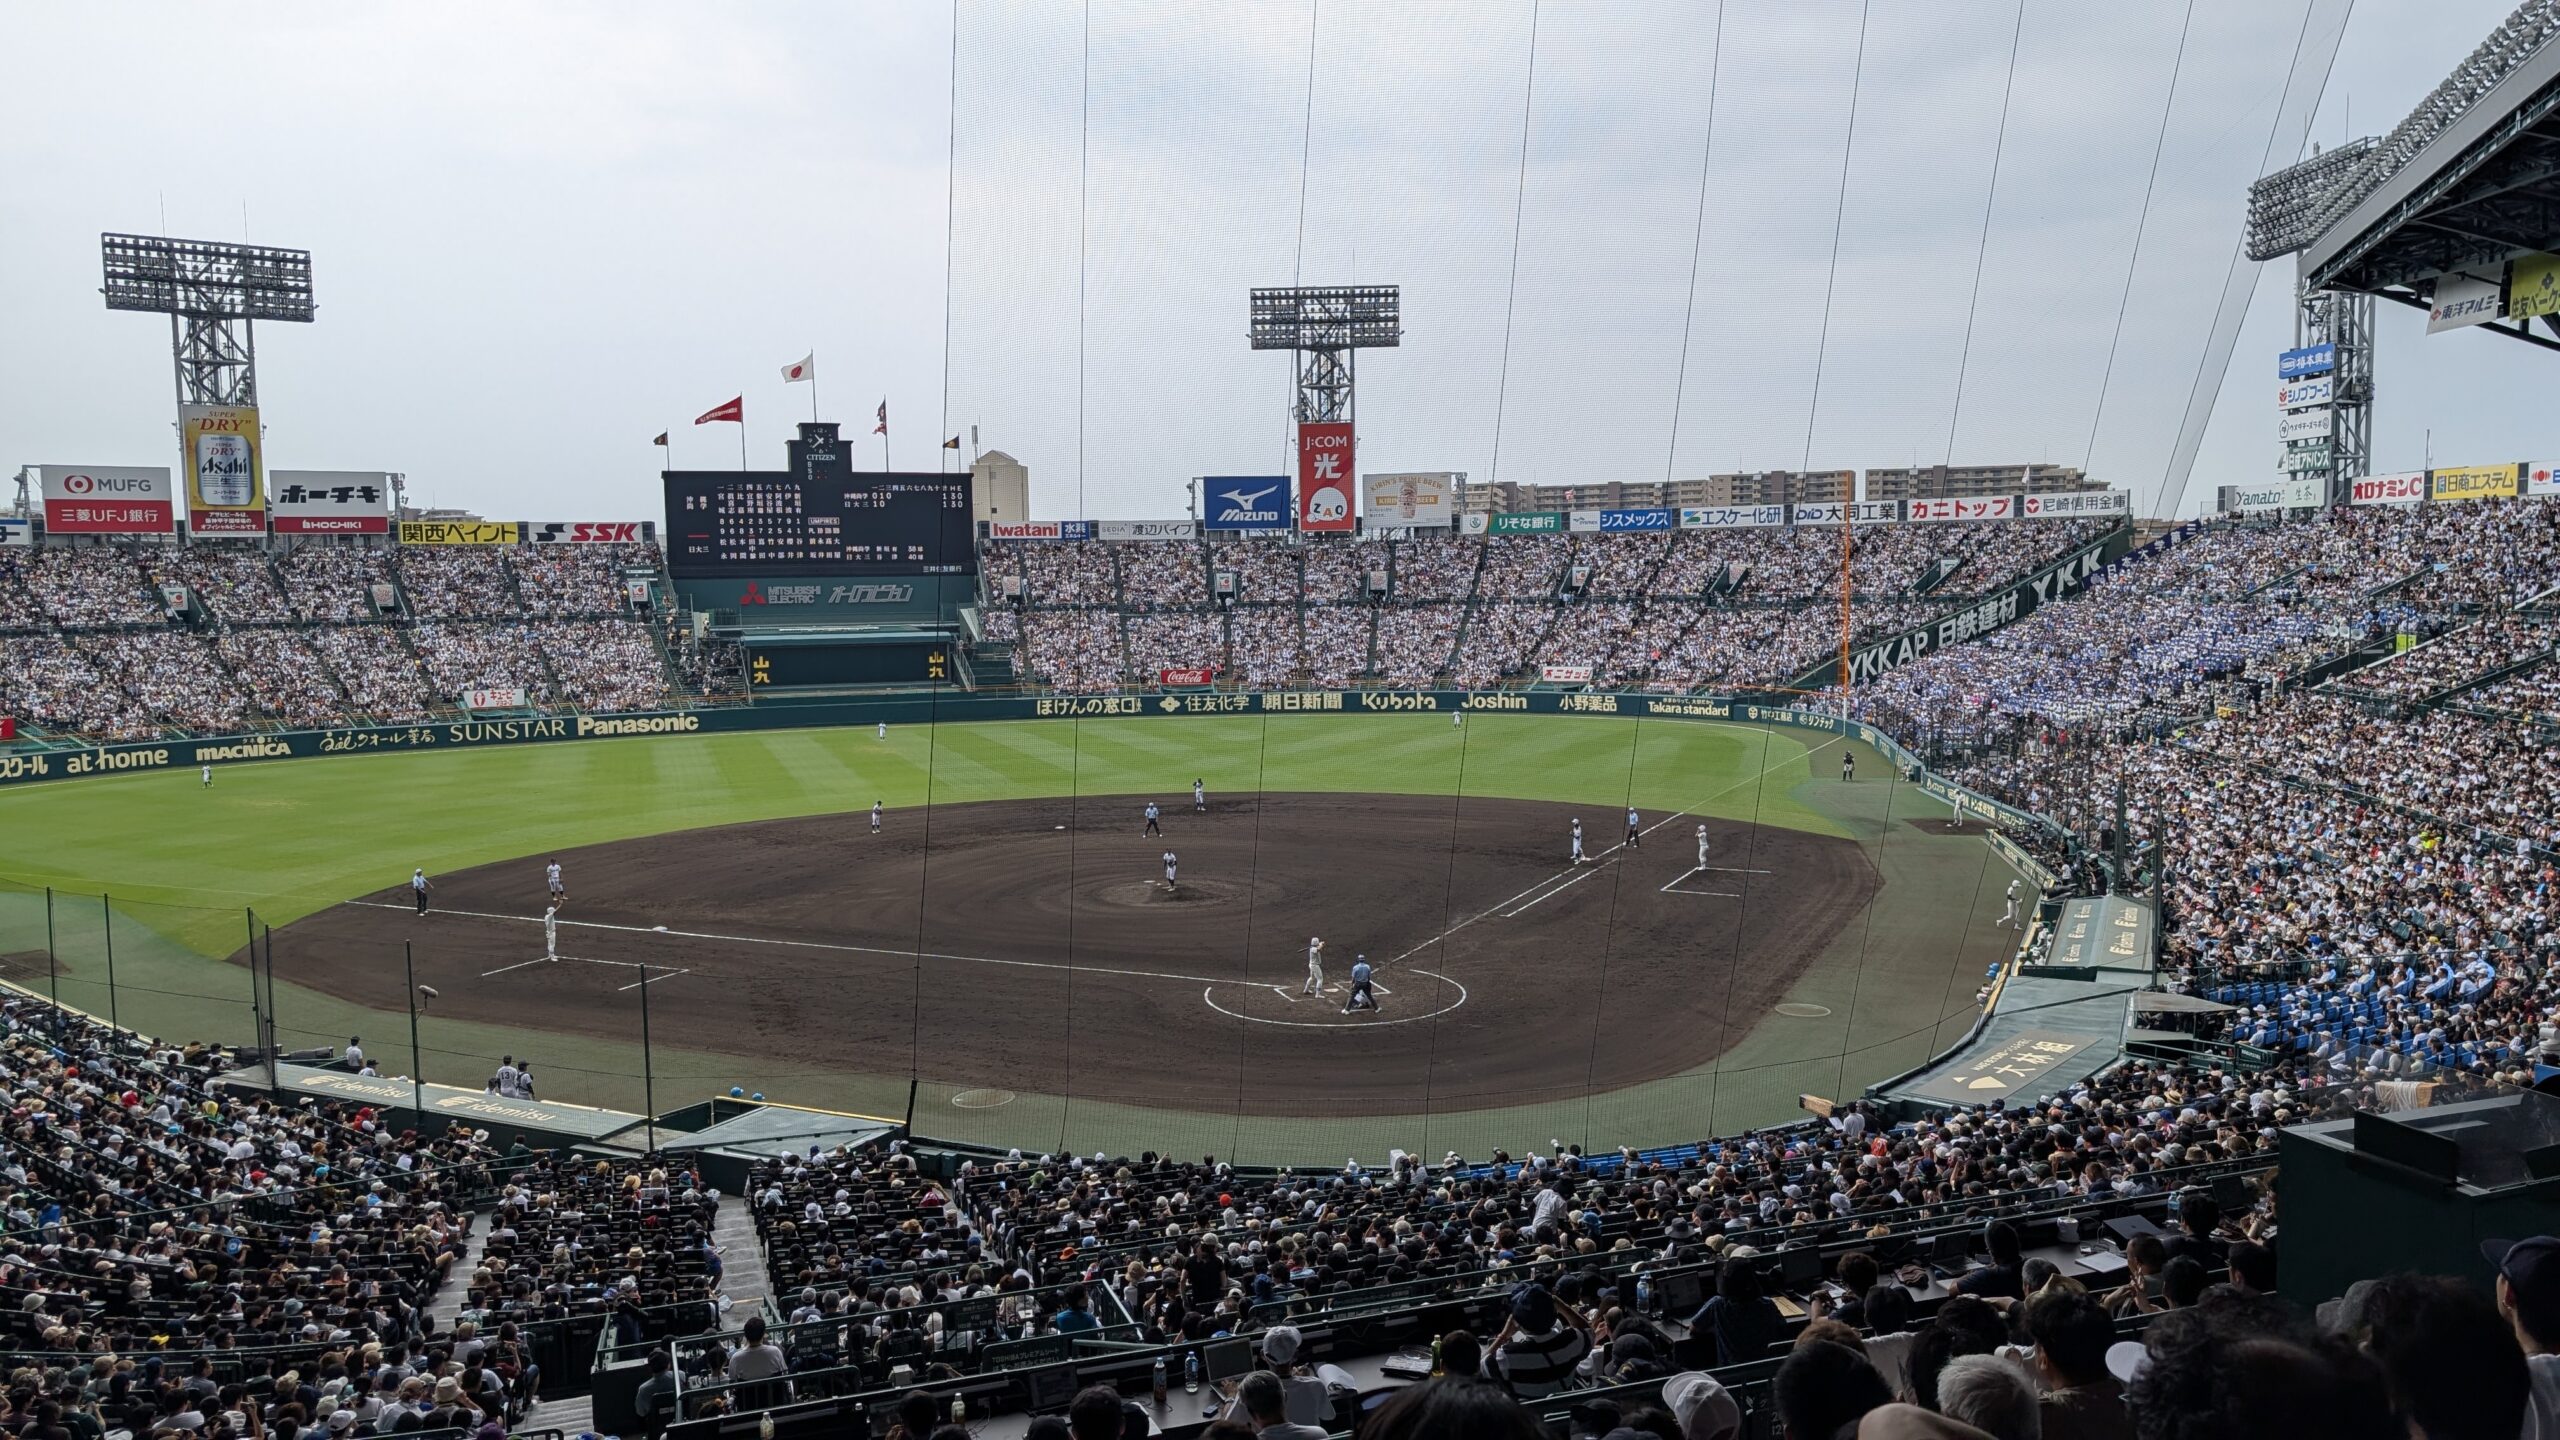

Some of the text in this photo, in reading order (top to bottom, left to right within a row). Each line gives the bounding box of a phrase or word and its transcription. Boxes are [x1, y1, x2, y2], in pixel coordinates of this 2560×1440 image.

[2442, 294, 2496, 320] 東洋アルミ
[2512, 288, 2560, 319] 住友ベーク
[2288, 382, 2331, 403] シノブフーズ
[208, 410, 236, 418] SUPER
[1305, 436, 1347, 451] J:COM
[202, 456, 247, 474] Asahi
[1314, 453, 1342, 479] 光
[97, 479, 152, 492] MUFG
[2353, 477, 2424, 501] オロナミンC
[2448, 471, 2514, 493] 日商エステム
[280, 485, 380, 503] ホーチキ
[2236, 490, 2280, 506] Yamato
[2296, 484, 2312, 501] 生茶
[1826, 504, 1896, 520] 大同工業
[1912, 498, 2010, 519] カニトップ
[2043, 494, 2126, 513] 尼崎信用金庫
[61, 509, 158, 523] 三菱UFJ銀行
[1498, 515, 1554, 529] りそな銀行
[1601, 512, 1668, 527] シスメックス
[1701, 507, 1782, 524] エスケー化研
[311, 521, 361, 529] HOCHIKI
[402, 524, 517, 543] 関西ペイント
[571, 523, 639, 542] SSK
[993, 523, 1058, 537] Iwatani
[1064, 523, 1086, 533] 水素
[1132, 523, 1193, 536] 渡辺パイプ
[2031, 547, 2103, 602] YKK
[767, 586, 821, 595] MITSUBISHI
[768, 595, 815, 604] ELECTRIC
[1938, 590, 2019, 648] 日鉄建材
[753, 656, 770, 684] 山九
[1543, 669, 1593, 680] 不二サッシ
[1037, 697, 1135, 715] ほけんの窓口
[1184, 695, 1250, 712] 住友化学
[1262, 693, 1343, 711] 朝日新聞
[1361, 693, 1436, 710] Kubota
[1461, 692, 1527, 709] Joshin
[1559, 695, 1617, 712] 小野薬品
[1648, 701, 1729, 717] Takara standard
[577, 712, 698, 736] Panasonic
[1761, 709, 1793, 723] 竹中工務店
[1808, 716, 1834, 730] リンテック
[450, 719, 566, 743] SUNSTAR
[67, 748, 168, 773] at home
[500, 1070, 510, 1079] 13
[330, 1078, 412, 1098] idemitsu
[466, 1100, 556, 1121] idemitsu
